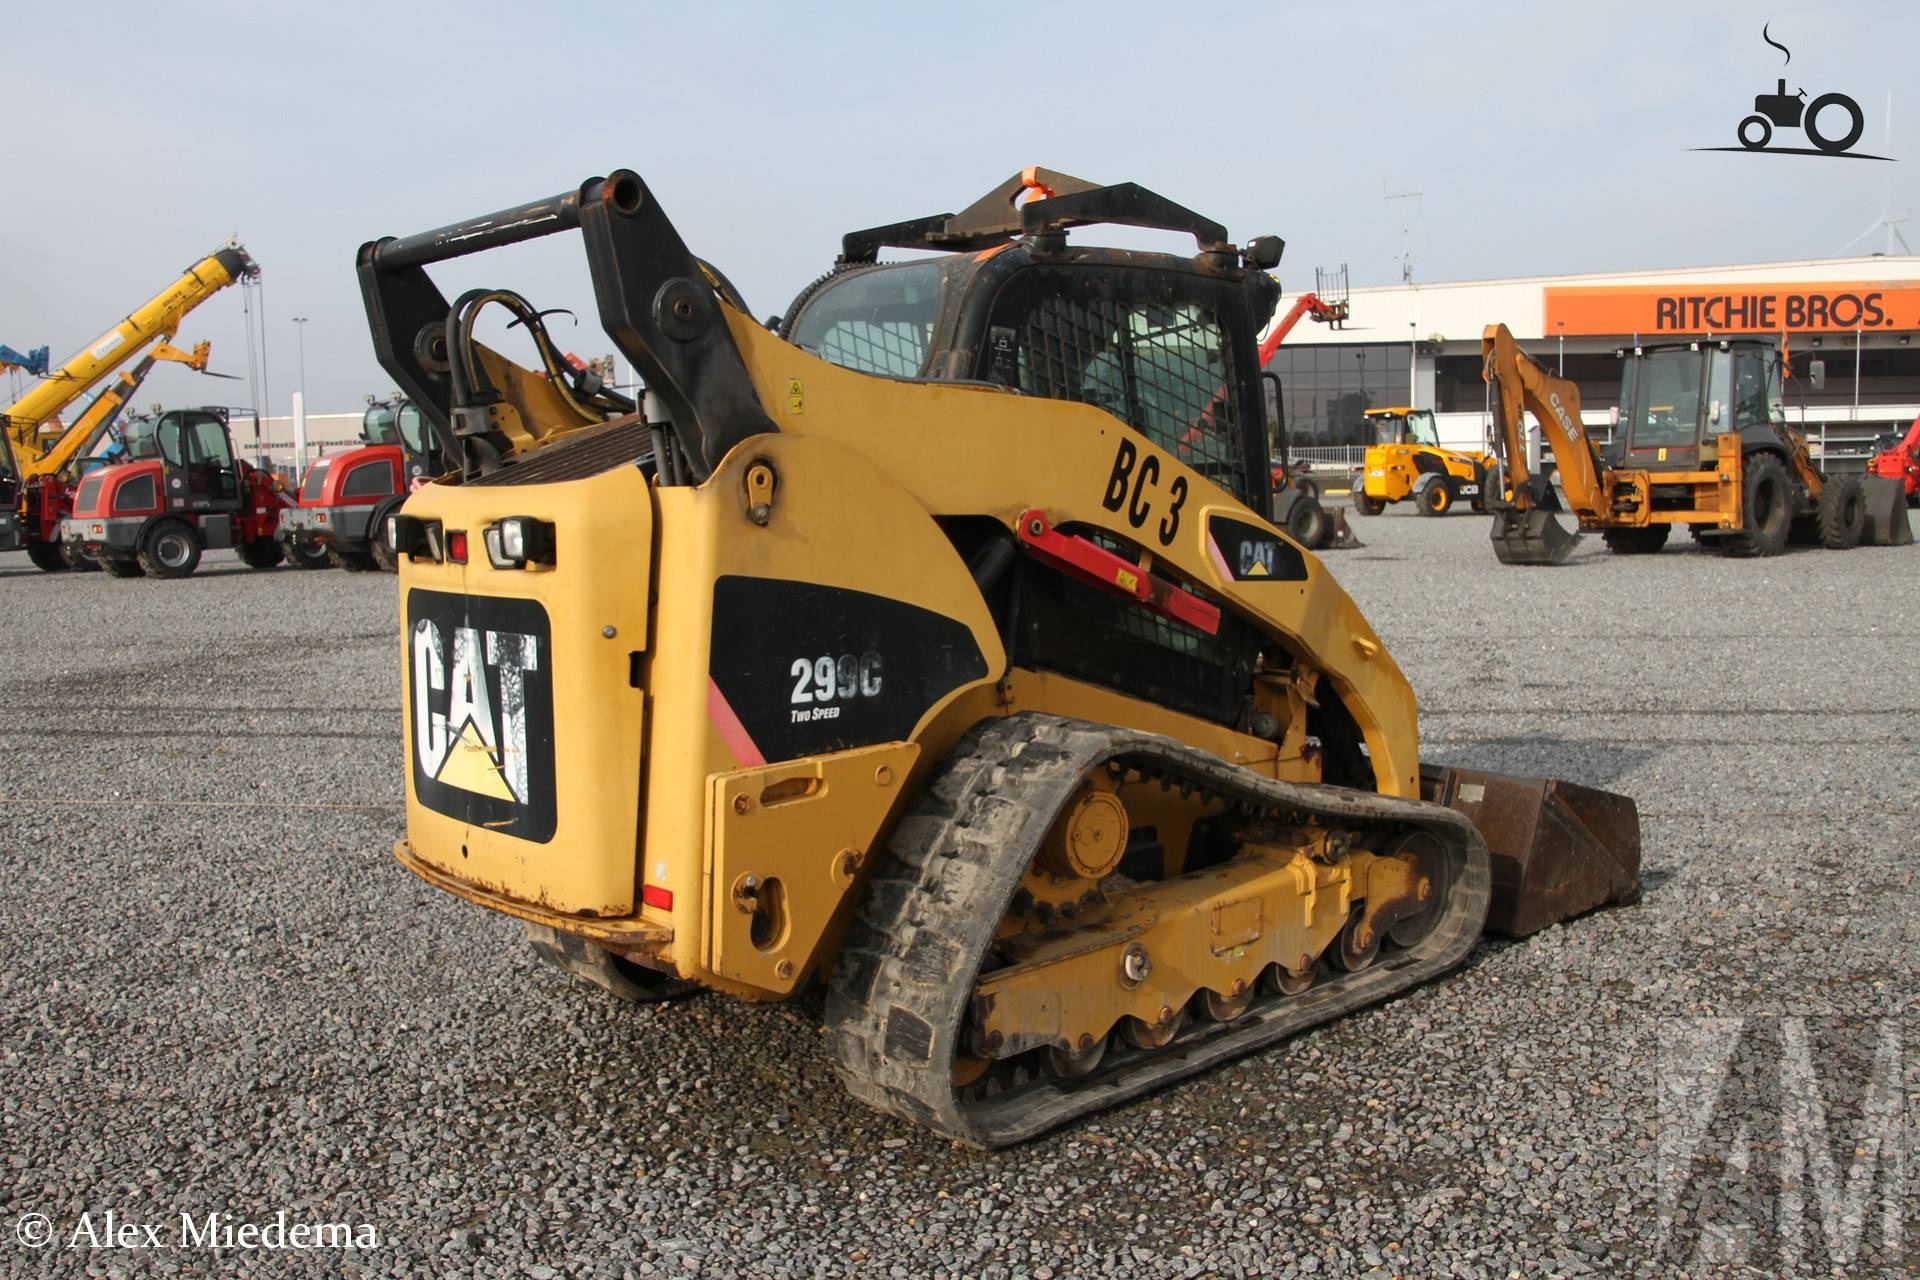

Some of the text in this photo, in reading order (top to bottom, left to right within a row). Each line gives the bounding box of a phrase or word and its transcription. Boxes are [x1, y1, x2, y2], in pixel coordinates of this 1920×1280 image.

[1656, 292, 1894, 330] RITCHIE BROS.
[1549, 392, 1579, 442] CASE
[1102, 437, 1188, 546] BC 3
[1459, 484, 1479, 495] JCB
[1239, 540, 1276, 576] CAT
[790, 650, 882, 704] 299C
[413, 617, 539, 805] CAT
